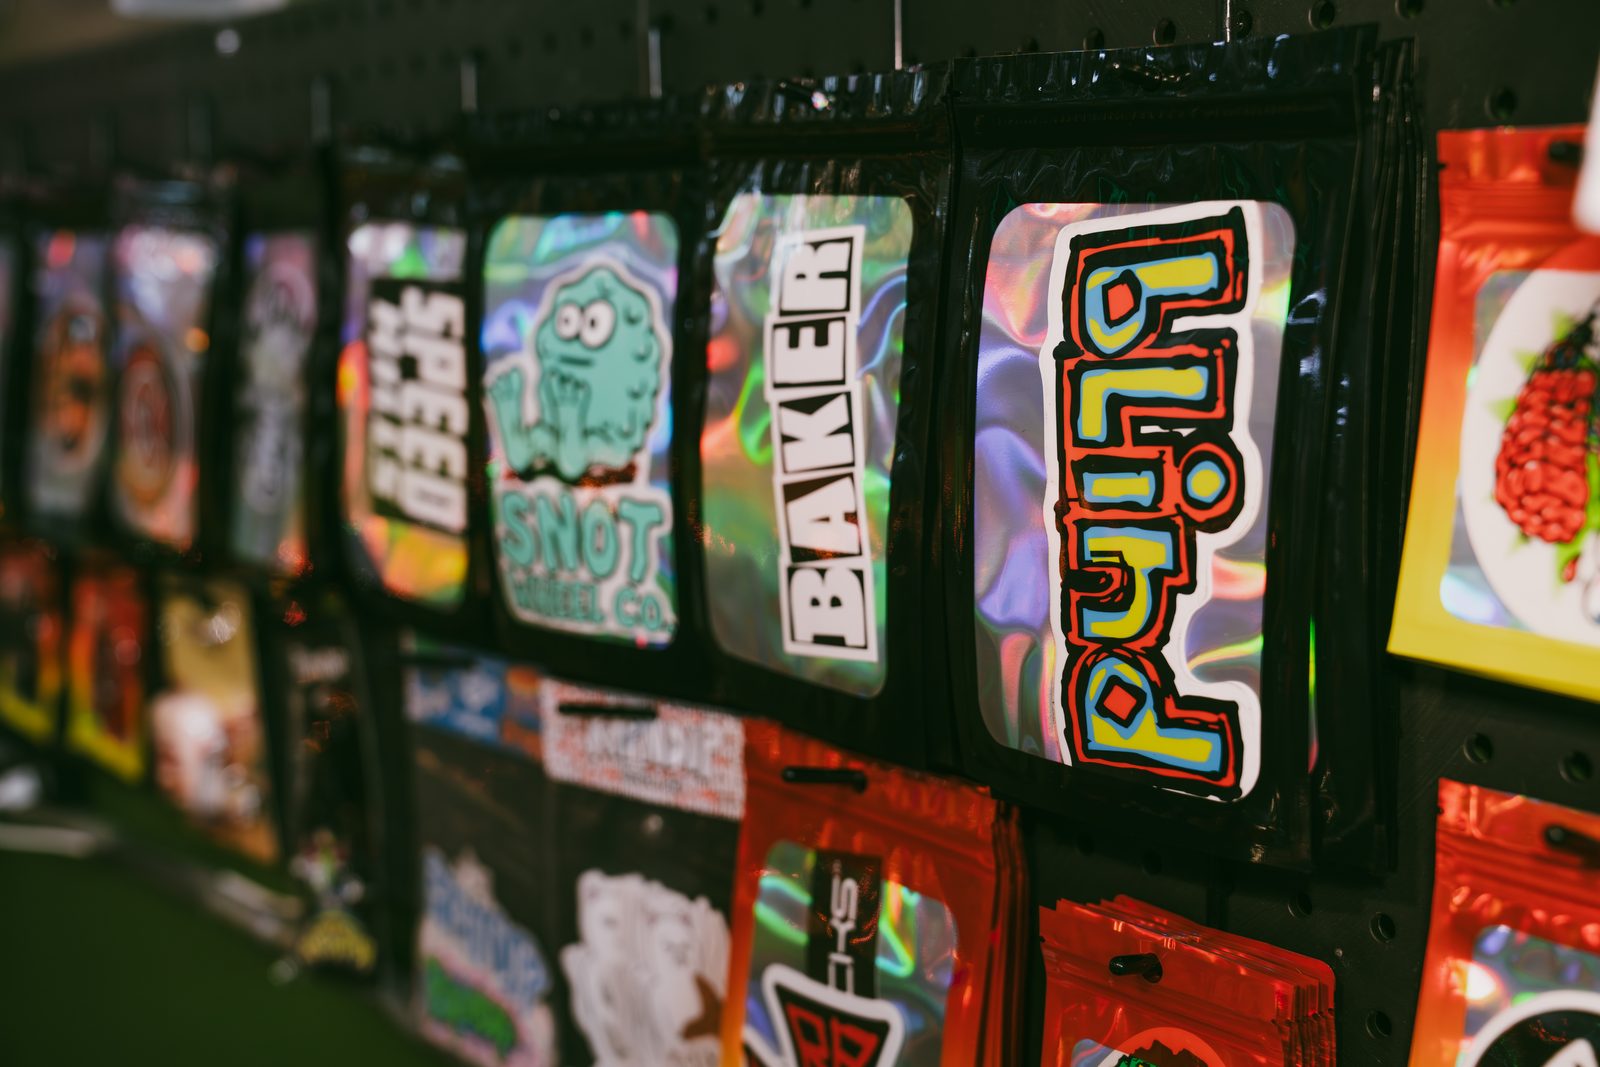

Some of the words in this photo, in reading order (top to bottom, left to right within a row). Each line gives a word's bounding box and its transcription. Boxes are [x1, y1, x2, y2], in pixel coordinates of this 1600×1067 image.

[399, 285, 468, 533] SPEED
[771, 235, 868, 649] BAKER
[501, 491, 663, 583] SNOT
